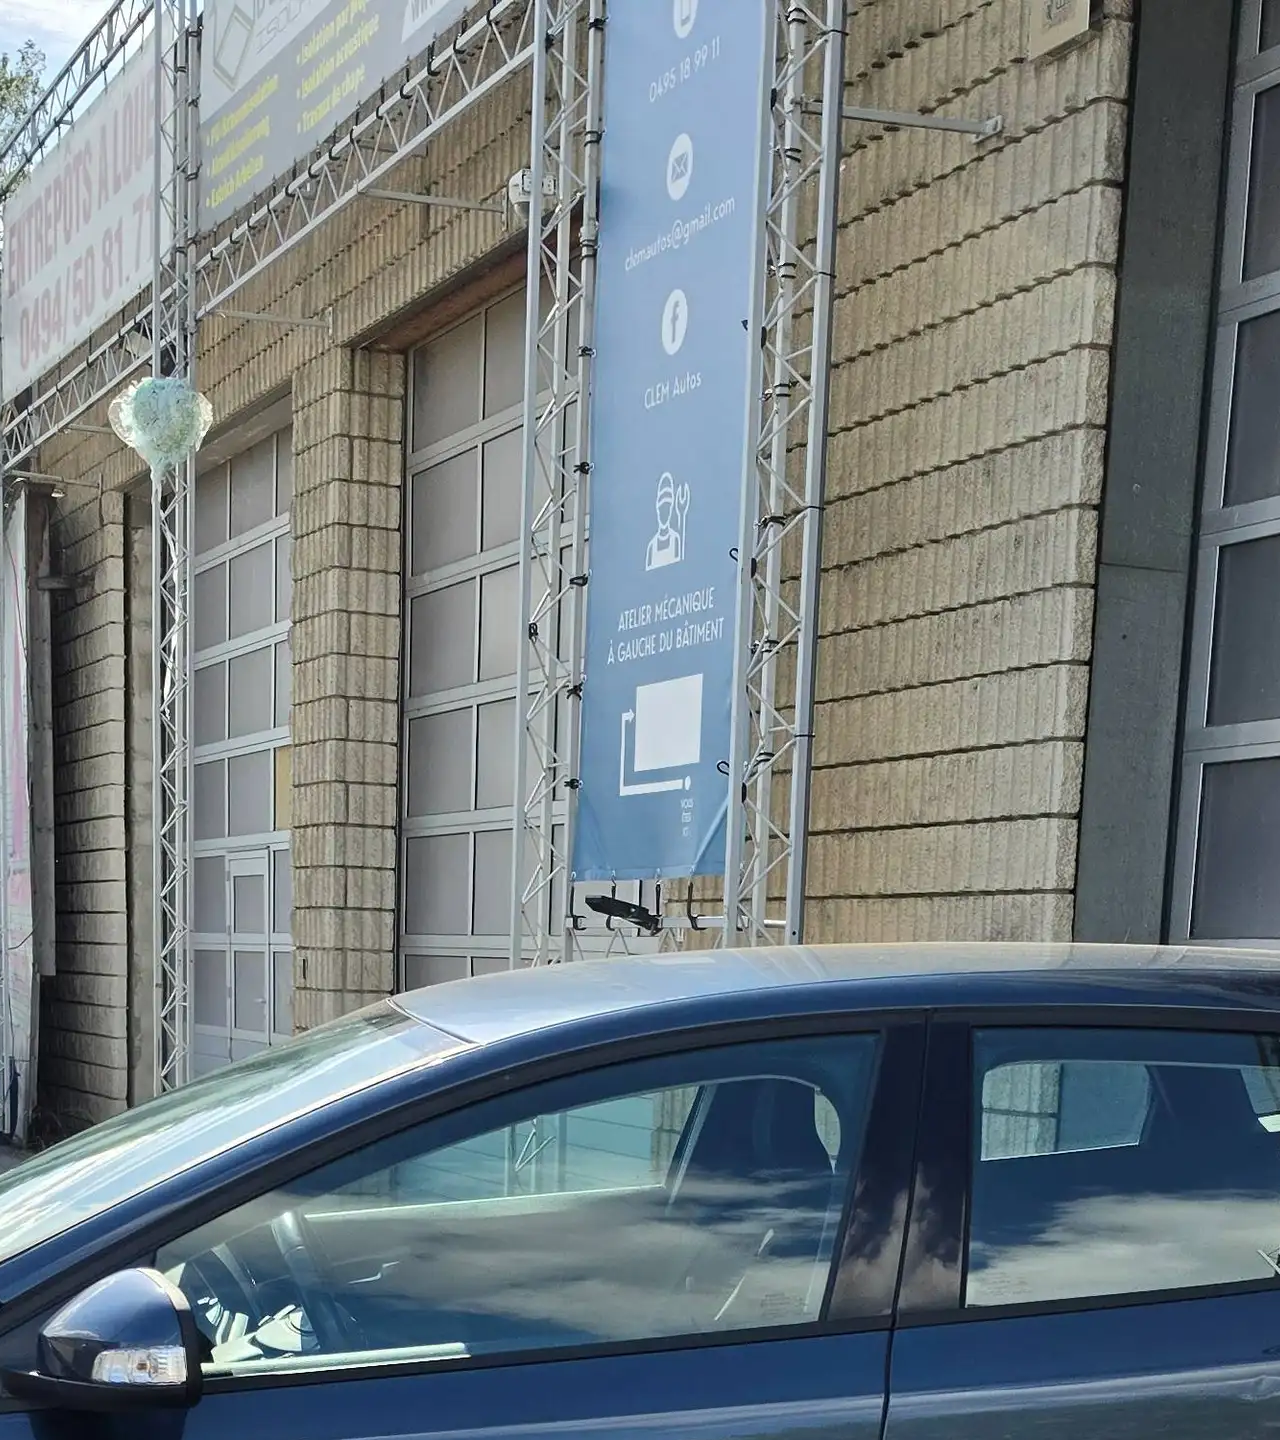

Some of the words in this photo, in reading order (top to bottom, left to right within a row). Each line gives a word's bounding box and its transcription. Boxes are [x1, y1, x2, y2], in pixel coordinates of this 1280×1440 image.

[649, 69, 677, 103] 0495
[680, 56, 692, 84] 18
[694, 44, 708, 73] 99
[711, 36, 720, 59] 11
[8, 141, 94, 299] ENTREPÔTS
[625, 196, 735, 272] clemautos@gmail.com
[644, 382, 669, 410] CLEM
[671, 371, 702, 398] Autos
[618, 604, 652, 633] ATELIER
[654, 586, 715, 622] MÉCANIQUE
[607, 638, 615, 665] À
[617, 633, 656, 663] GAUCHE
[659, 629, 673, 651] DU
[675, 617, 725, 648] BÂTIMENT
